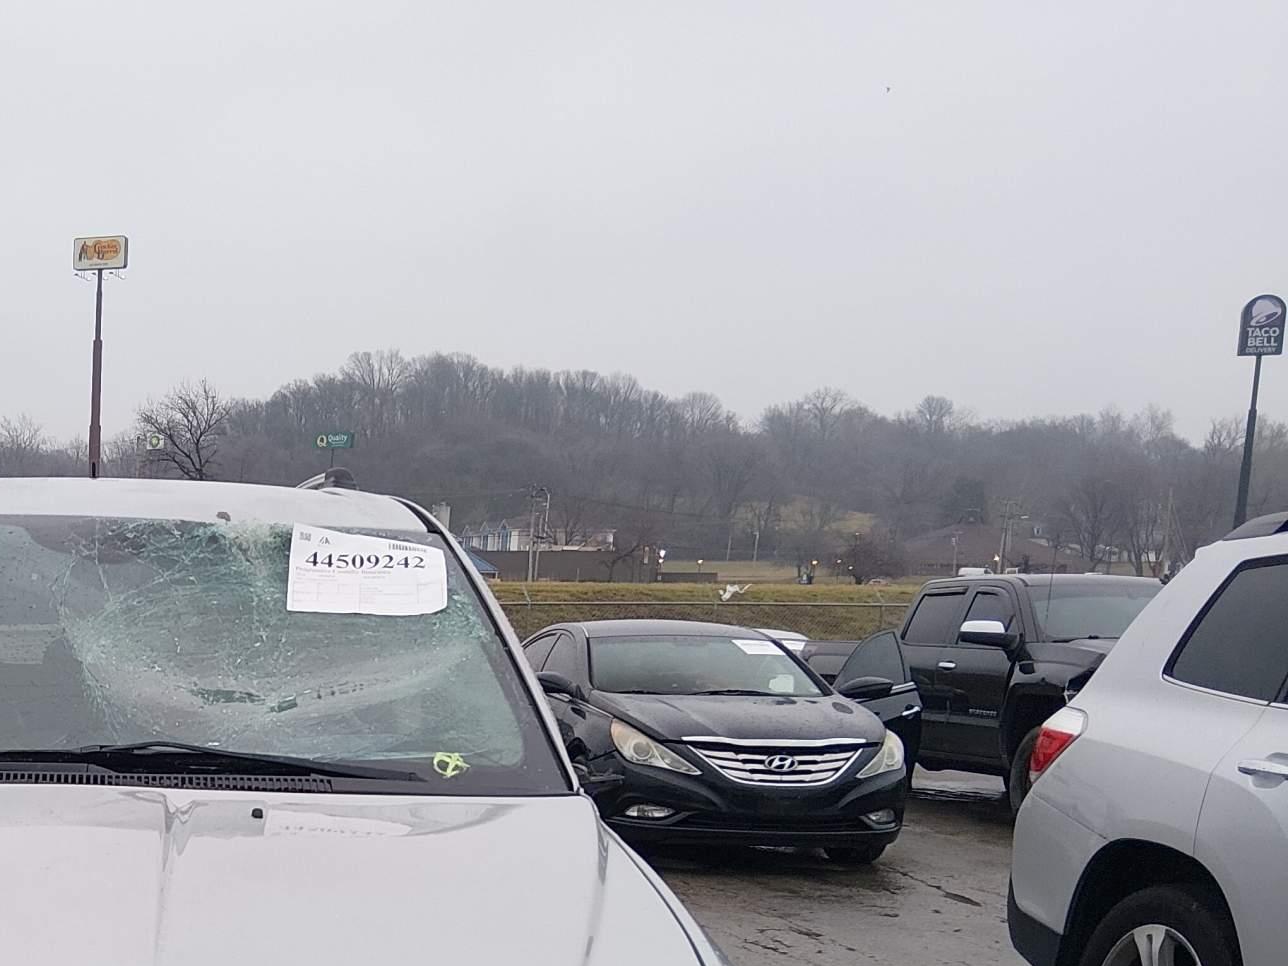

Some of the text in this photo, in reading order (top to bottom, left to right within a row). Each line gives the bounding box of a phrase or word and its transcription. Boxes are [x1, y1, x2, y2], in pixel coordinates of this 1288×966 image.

[1246, 327, 1280, 337] TACO
[1247, 337, 1278, 347] BELL
[305, 551, 426, 569] 44509242
